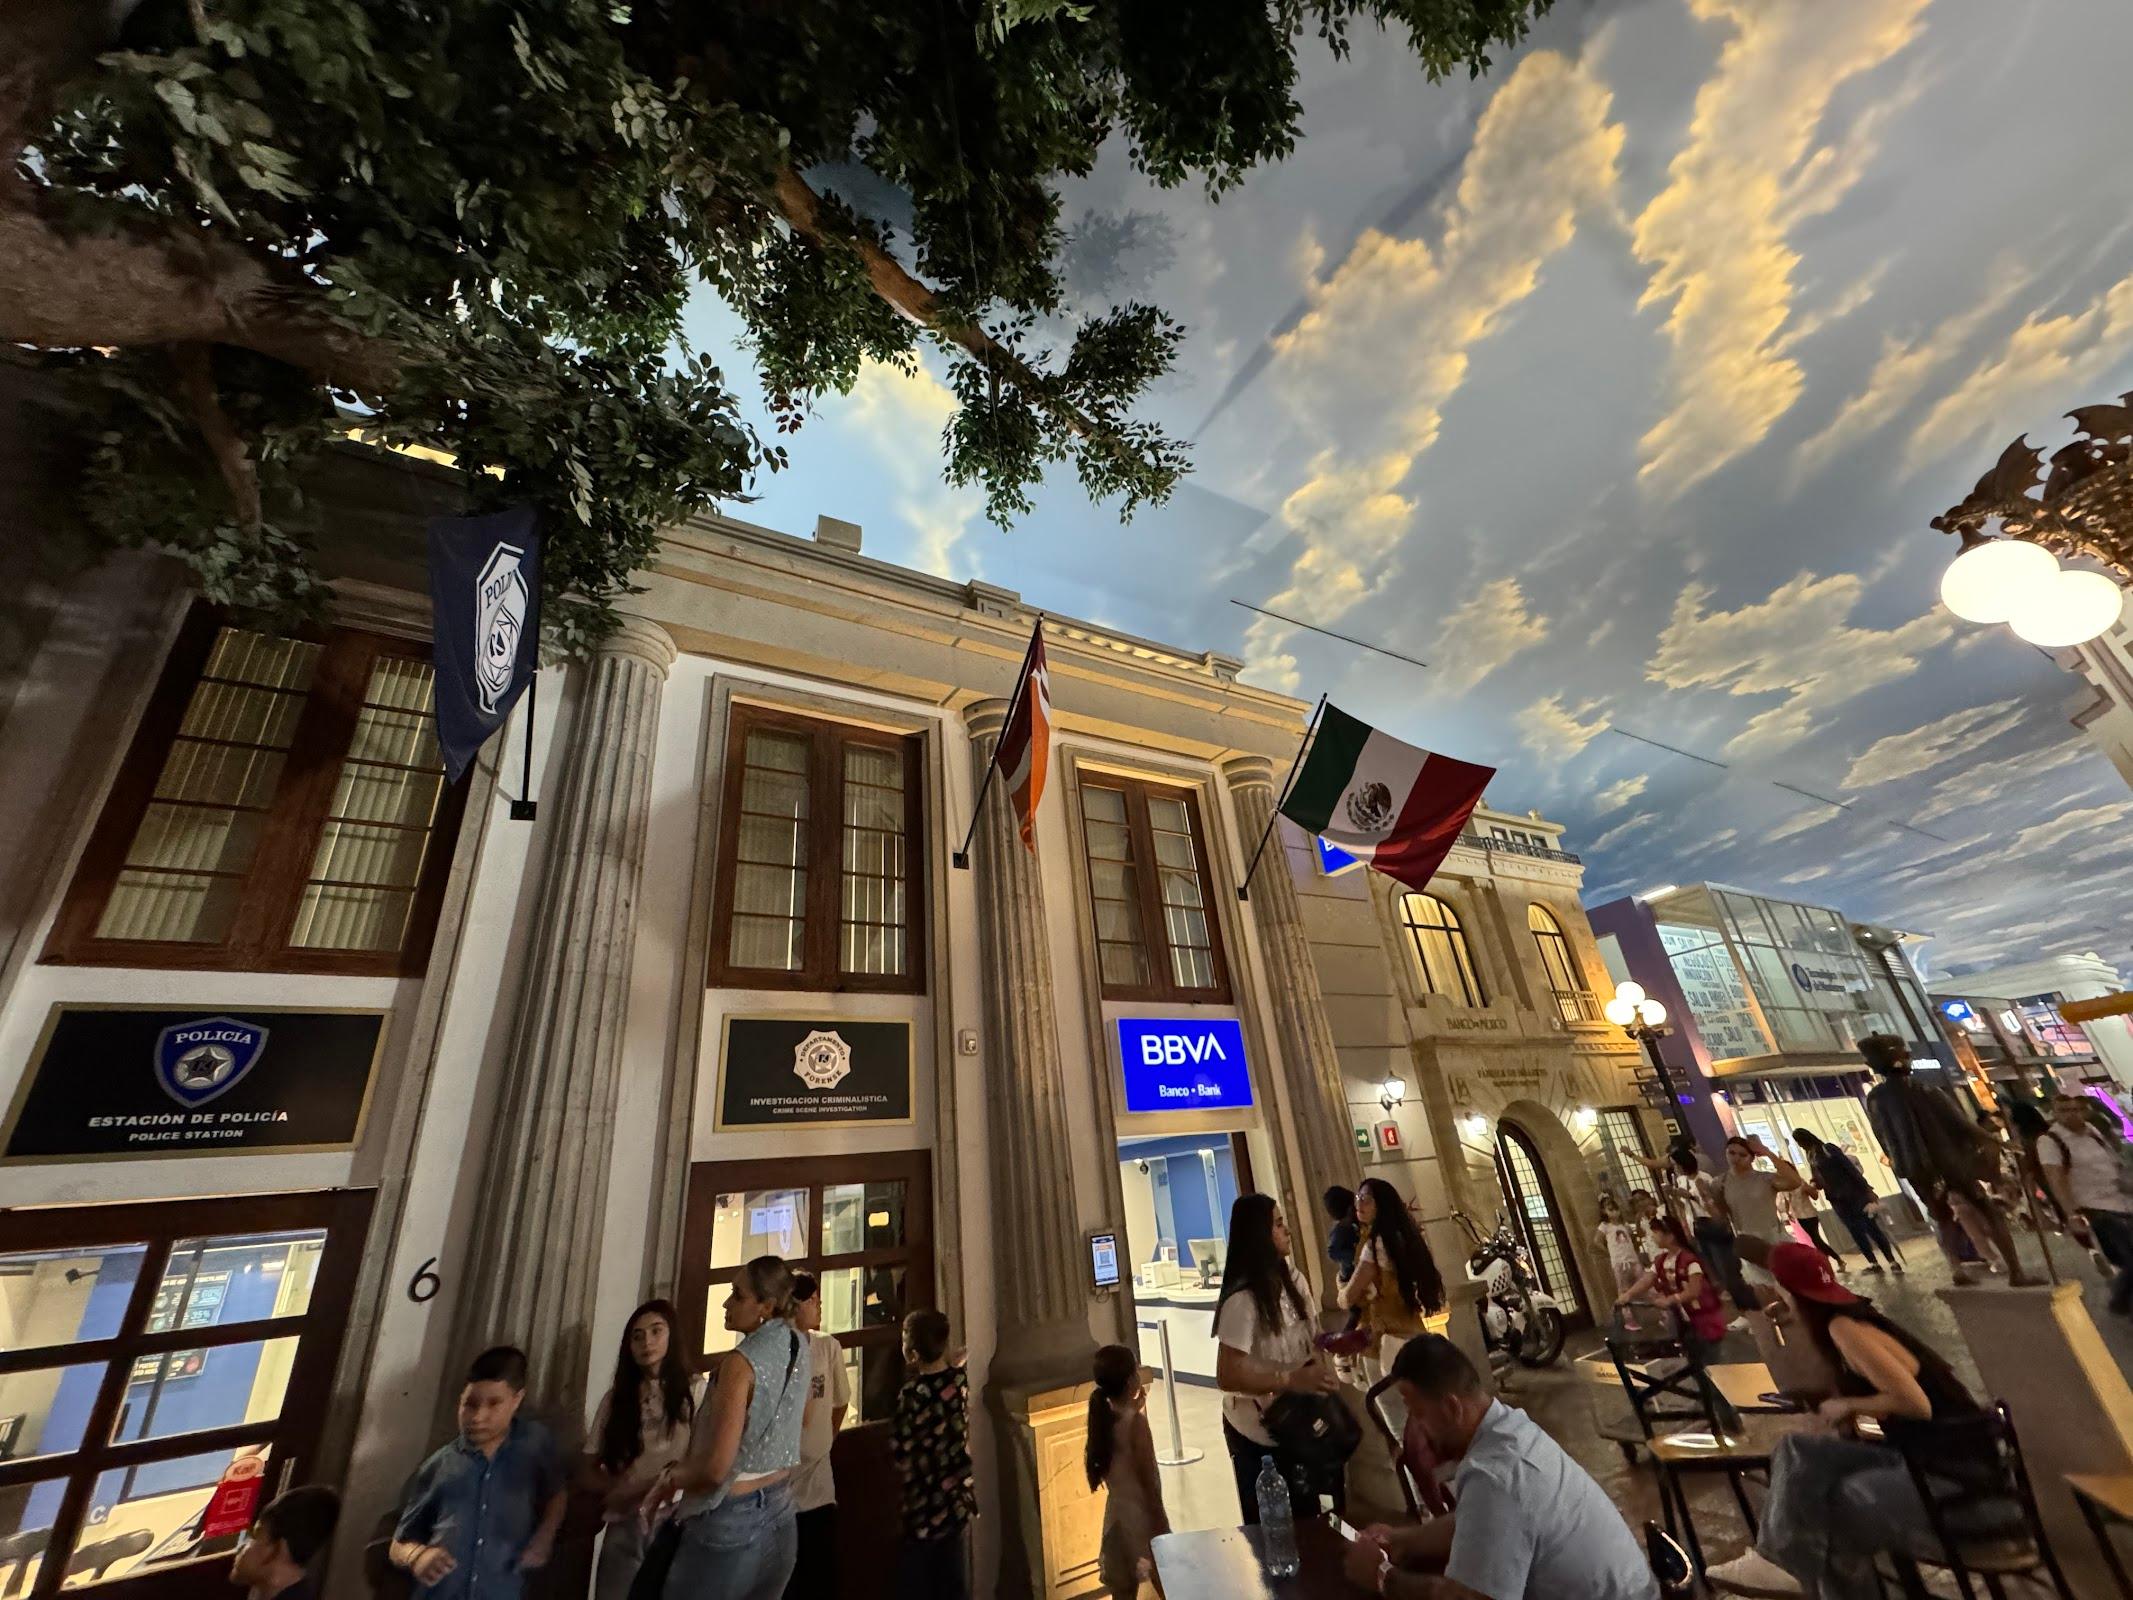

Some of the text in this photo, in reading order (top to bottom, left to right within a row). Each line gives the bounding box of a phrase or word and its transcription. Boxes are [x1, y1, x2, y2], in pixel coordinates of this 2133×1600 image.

[175, 1030, 252, 1045] POLICÍA
[801, 1036, 846, 1057] DEPARTAMENTO
[1140, 1032, 1227, 1065] BBVA
[804, 1070, 843, 1084] FORENSE
[1159, 1083, 1222, 1097] Banco Bank
[818, 1105, 868, 1113] INVESTIGATION
[88, 1110, 288, 1127] ESTACIÓN DE POLICÍA
[129, 1129, 243, 1141] POLICE STATION
[407, 1257, 441, 1303] 6
